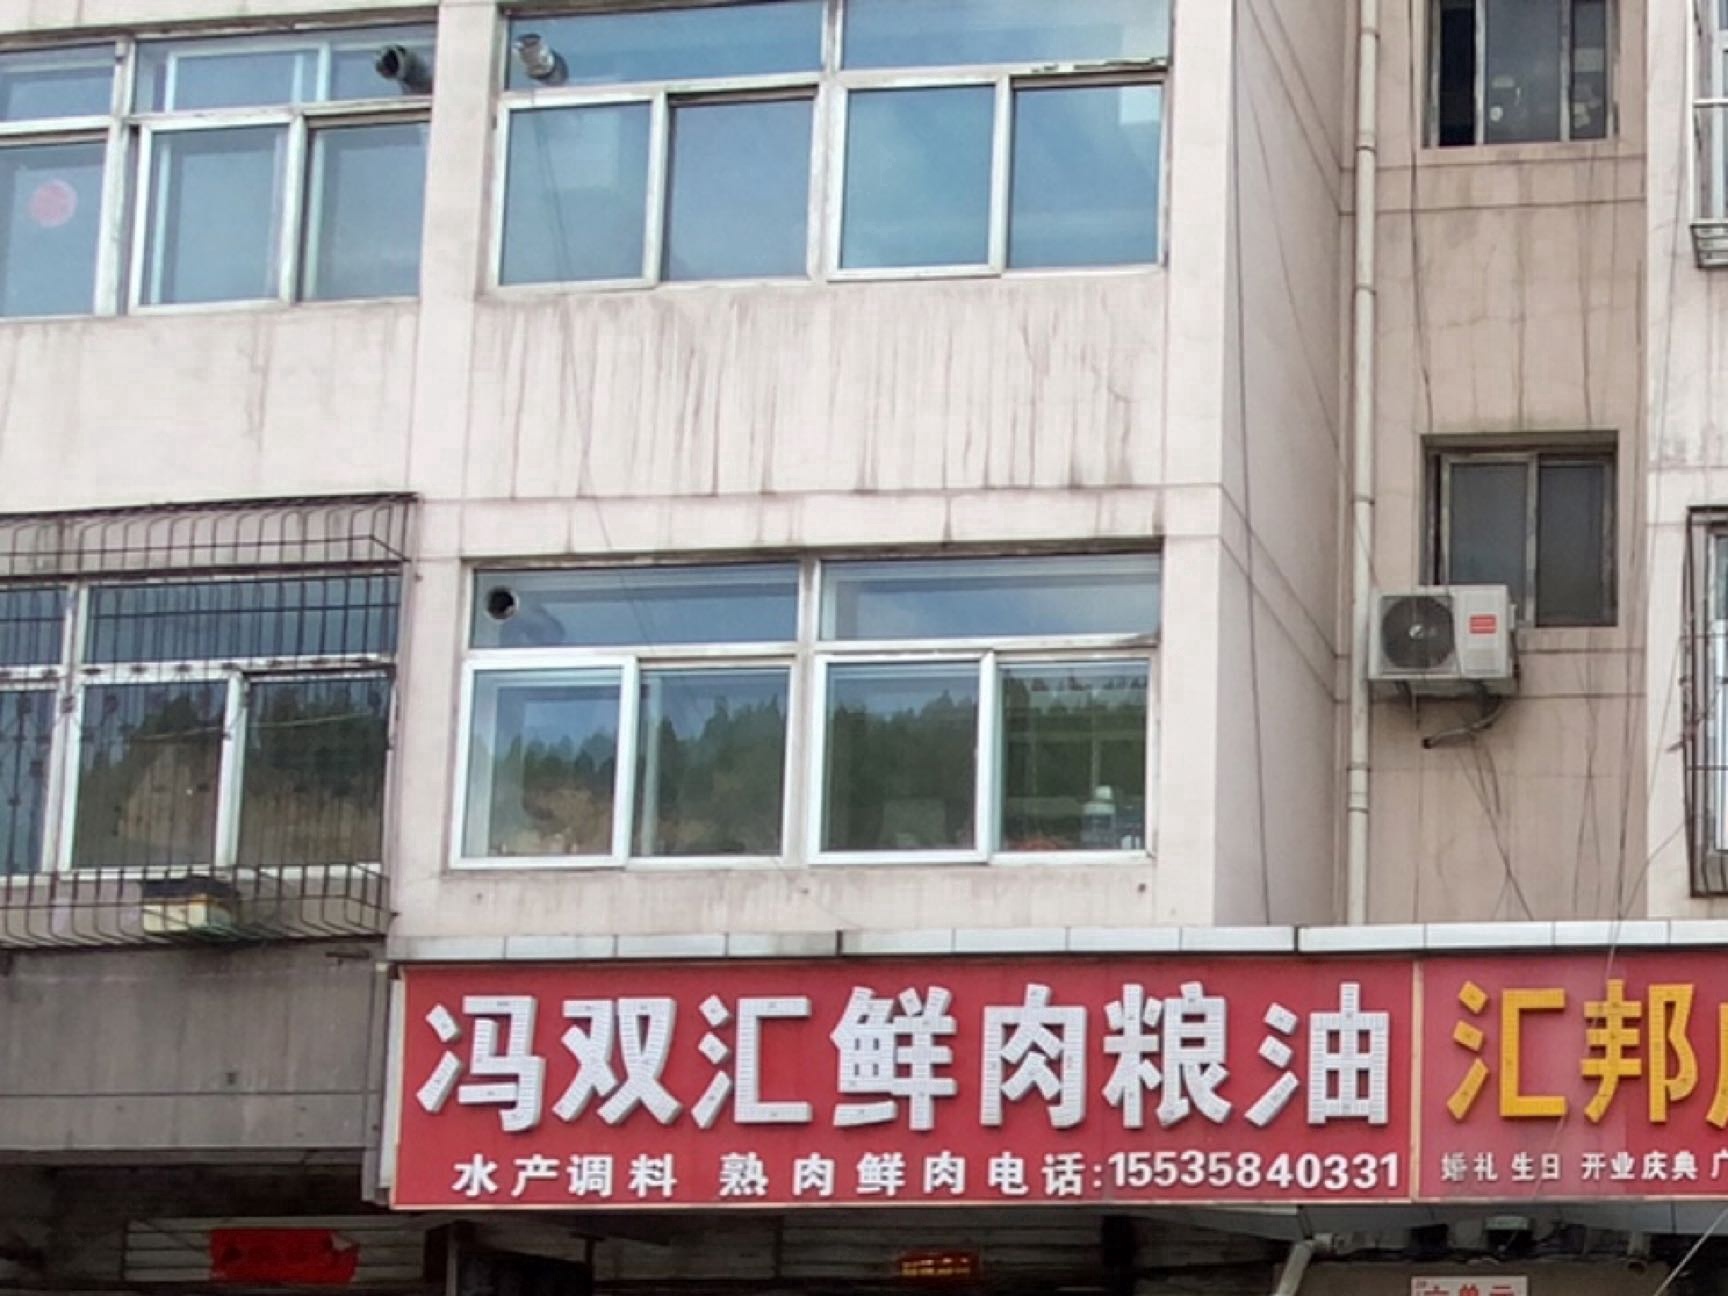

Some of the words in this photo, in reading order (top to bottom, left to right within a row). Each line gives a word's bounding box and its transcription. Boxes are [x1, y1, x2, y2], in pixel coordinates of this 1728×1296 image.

[415, 980, 1388, 1132] 冯双汇鲜肉粮油
[453, 1154, 677, 1198] 水产调料
[1511, 1152, 1562, 1183] 生日
[1581, 1149, 1698, 1181] 开业庆典
